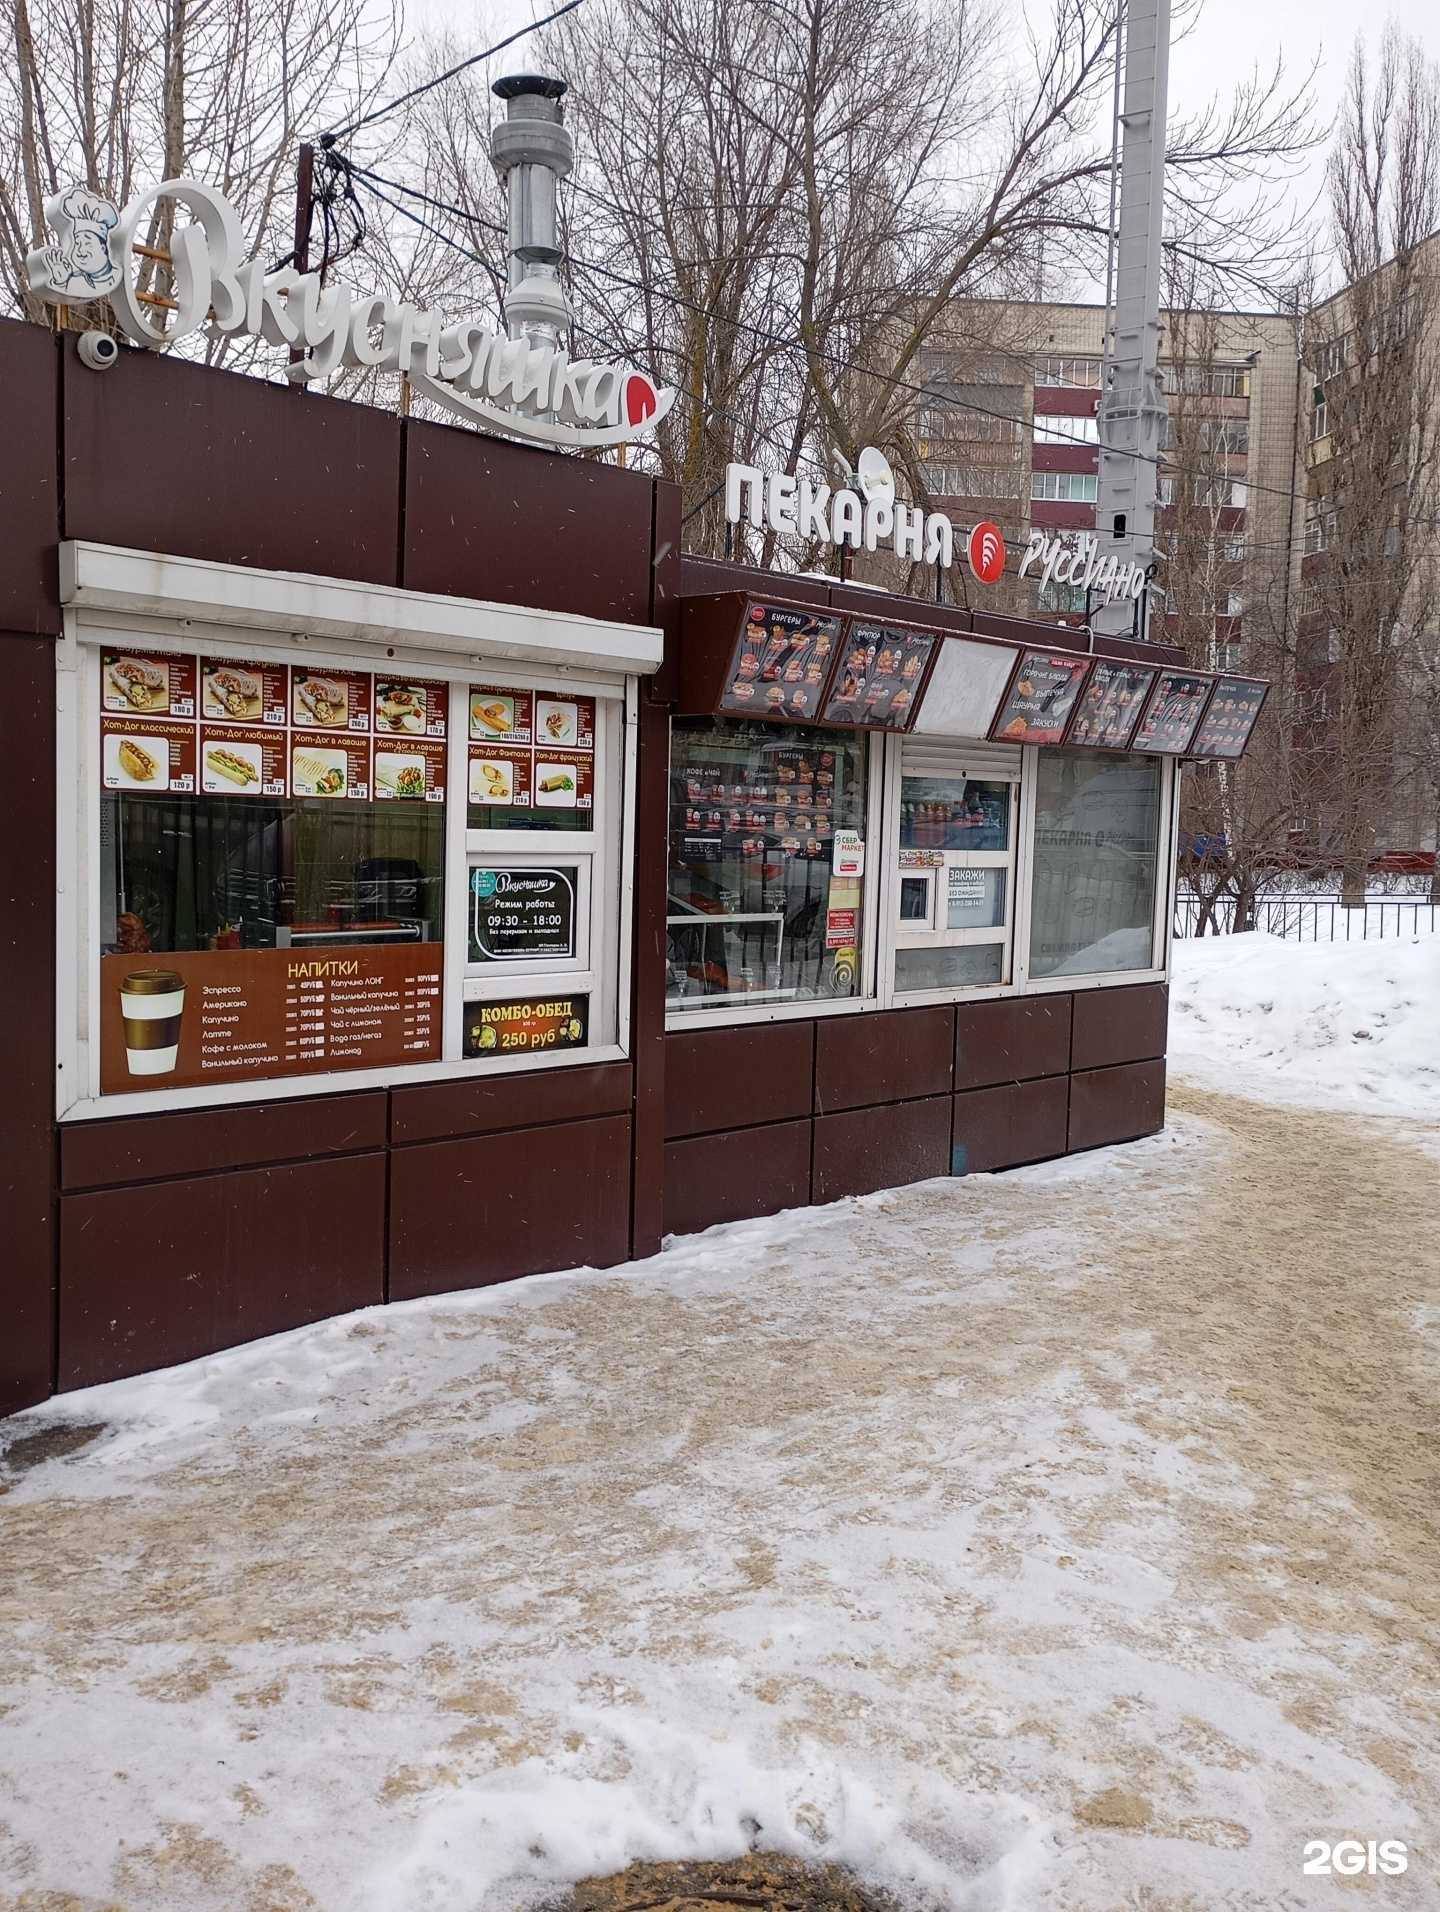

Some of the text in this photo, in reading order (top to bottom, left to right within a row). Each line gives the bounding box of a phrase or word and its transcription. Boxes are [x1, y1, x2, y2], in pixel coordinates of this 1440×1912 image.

[726, 462, 953, 568] ПЕКАРНЯ
[771, 613, 801, 625] БУРГЕРЫ
[103, 719, 139, 732] Хот-Дог
[204, 727, 243, 738] Хот-Дог
[949, 870, 985, 880] ЗАКАЖИ
[495, 899, 556, 911] Режим работы
[487, 915, 518, 927] 09:30
[533, 915, 562, 926] 18:00
[288, 961, 359, 978] НАПИТКИ
[330, 979, 364, 989] Капучино
[202, 986, 241, 995] Эспрессо
[202, 1000, 247, 1010] Американо
[481, 1002, 573, 1023] КОМБО-ОБЕД
[202, 1015, 239, 1025] Капучино
[330, 1019, 344, 1029] Чай
[202, 1031, 232, 1039] Латте
[502, 1028, 556, 1048] 250 руб
[202, 1044, 225, 1054] Кофе
[232, 1042, 268, 1051] молоком
[330, 1048, 362, 1056] Лимонад
[201, 1055, 279, 1068] Ванильный капучино
